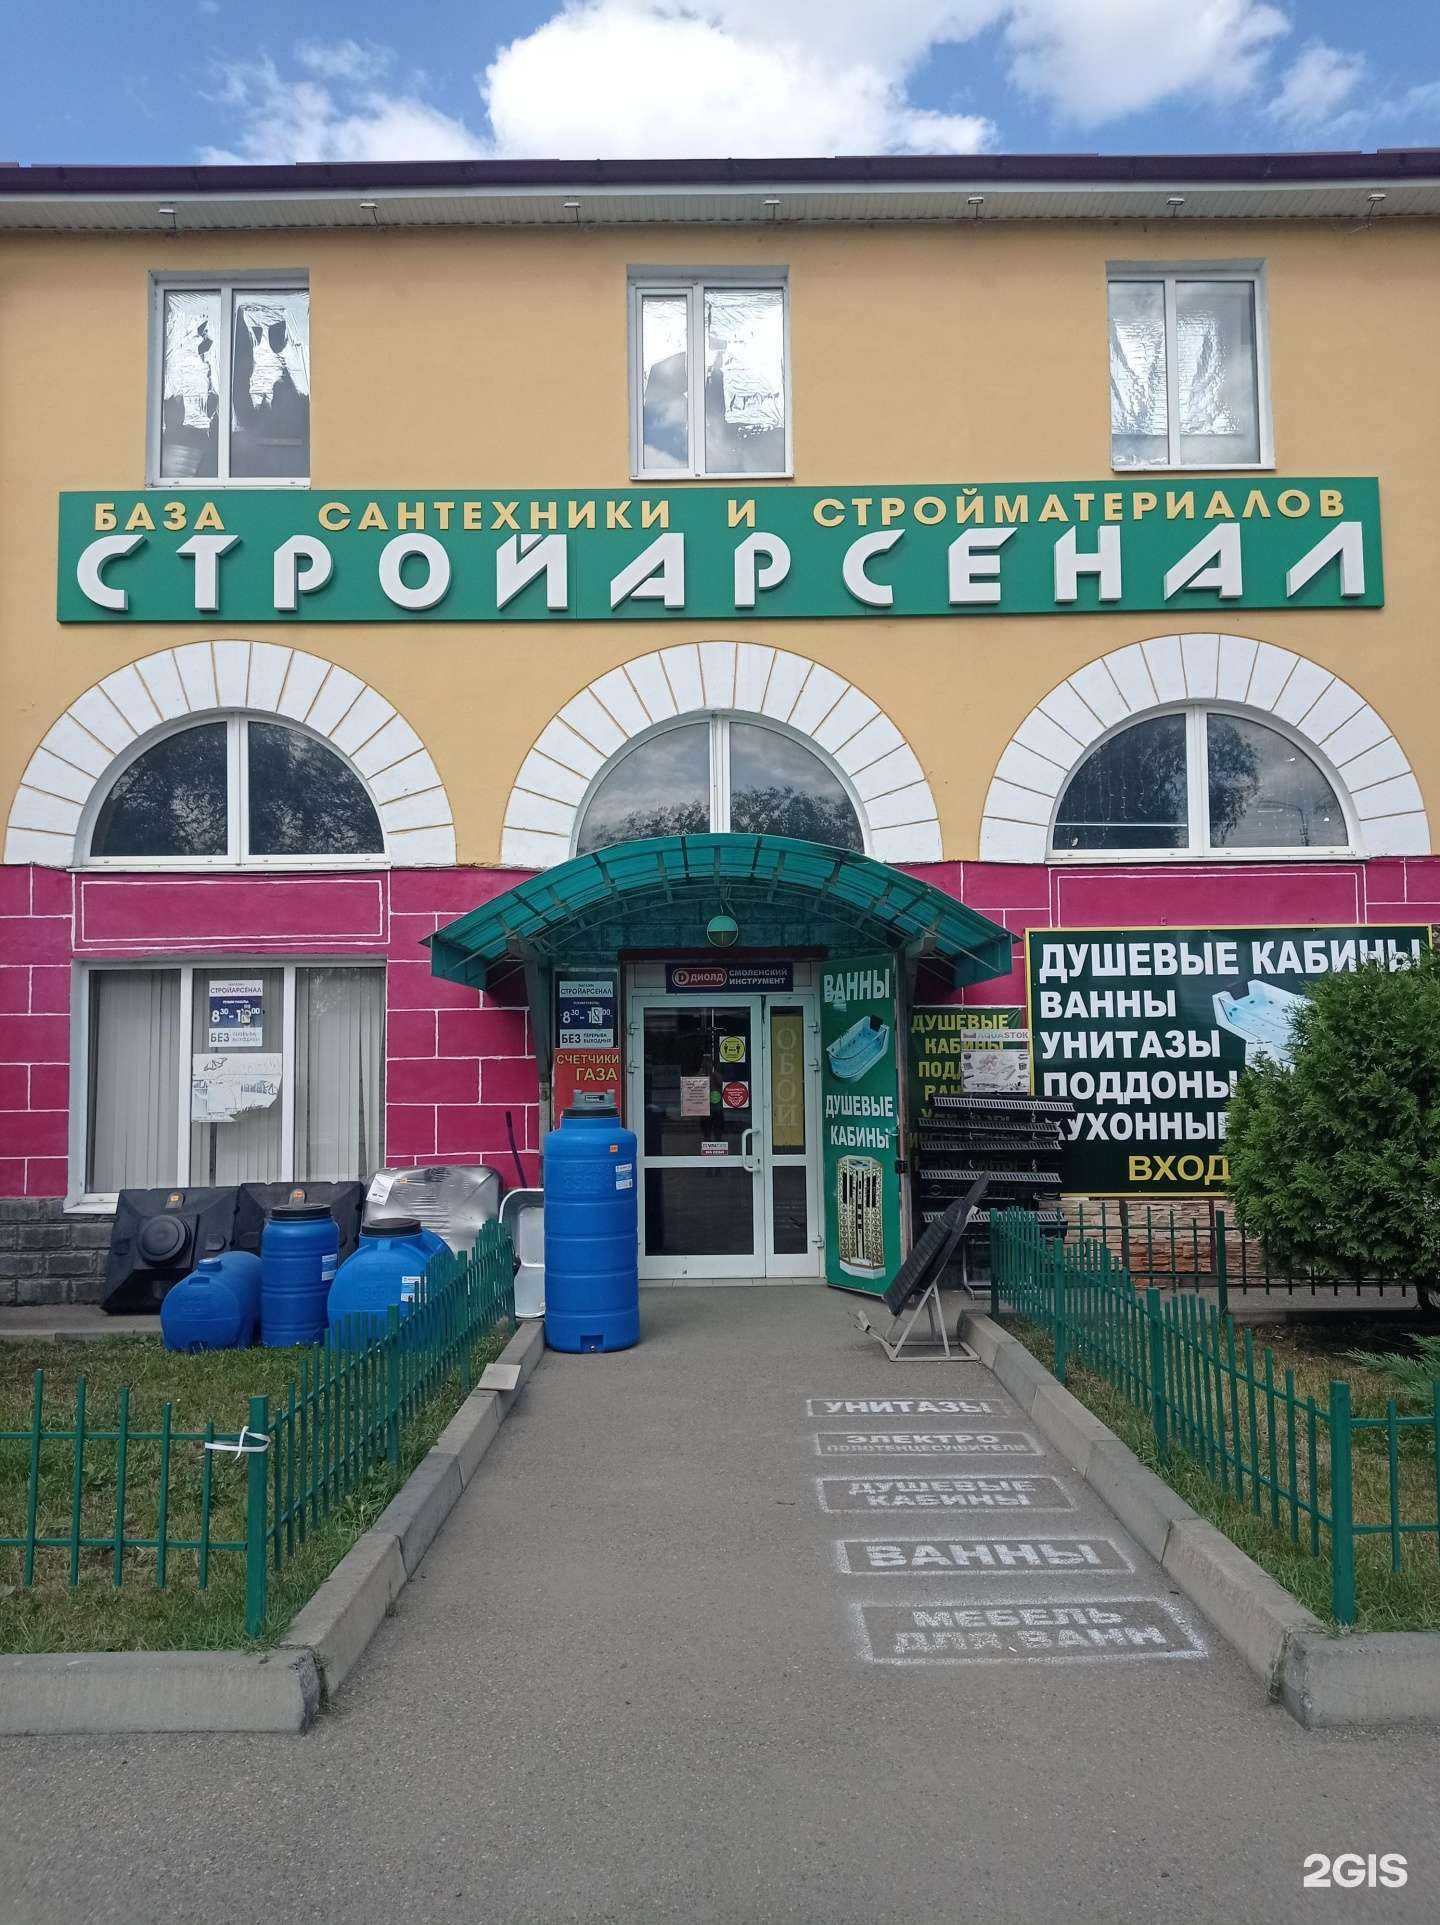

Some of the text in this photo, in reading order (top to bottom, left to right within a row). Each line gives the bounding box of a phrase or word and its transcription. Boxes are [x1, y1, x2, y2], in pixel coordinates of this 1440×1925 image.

[94, 488, 1346, 531] БАЗА САНТЕХНИКИ И СТРОЙМАТЕРИАЛОВ
[76, 521, 1366, 612] СТРОЙАРСЕНАЛ
[1039, 938, 1421, 984] ДУШЕВЫЕ КАБИНЫ
[690, 967, 787, 983] ДИОЛД СМОЛЕНСКИЙ
[729, 977, 786, 985] ИНСТРУМЕНТ
[560, 988, 612, 996] СТРОЙАРСЕНАЛ
[823, 968, 890, 1003] ВАННЫ
[1040, 990, 1177, 1019] ВАННЫ
[911, 1014, 1009, 1034] ДУШЕВЫЕ
[210, 1032, 230, 1043] БЕЗ
[561, 1033, 581, 1044] БЕЗ
[976, 1031, 1029, 1040] AQUASTOK
[1040, 1030, 1221, 1060] УНИТАЗЫ
[556, 1054, 620, 1065] СЧЕТЧИКИ
[576, 1067, 618, 1081] ГАЗА
[775, 1027, 801, 1127] ОБОИ
[1043, 1070, 1239, 1106] ПОДДОНЫ
[826, 1094, 894, 1119] ДУШЕВЫЕ
[830, 1125, 890, 1149] КАБИНЫ
[1128, 1155, 1231, 1186] ВХОД
[825, 1400, 992, 1414] УНИТАЗЫ
[846, 1433, 999, 1444] ЭЛЕКТРО
[848, 1480, 1036, 1496] ДУШЕВЫЕ
[866, 1494, 1031, 1507] КАБИНЫ
[866, 1544, 1102, 1567] ВАННЫ
[912, 1607, 1123, 1628] МЕБЕЛЬ
